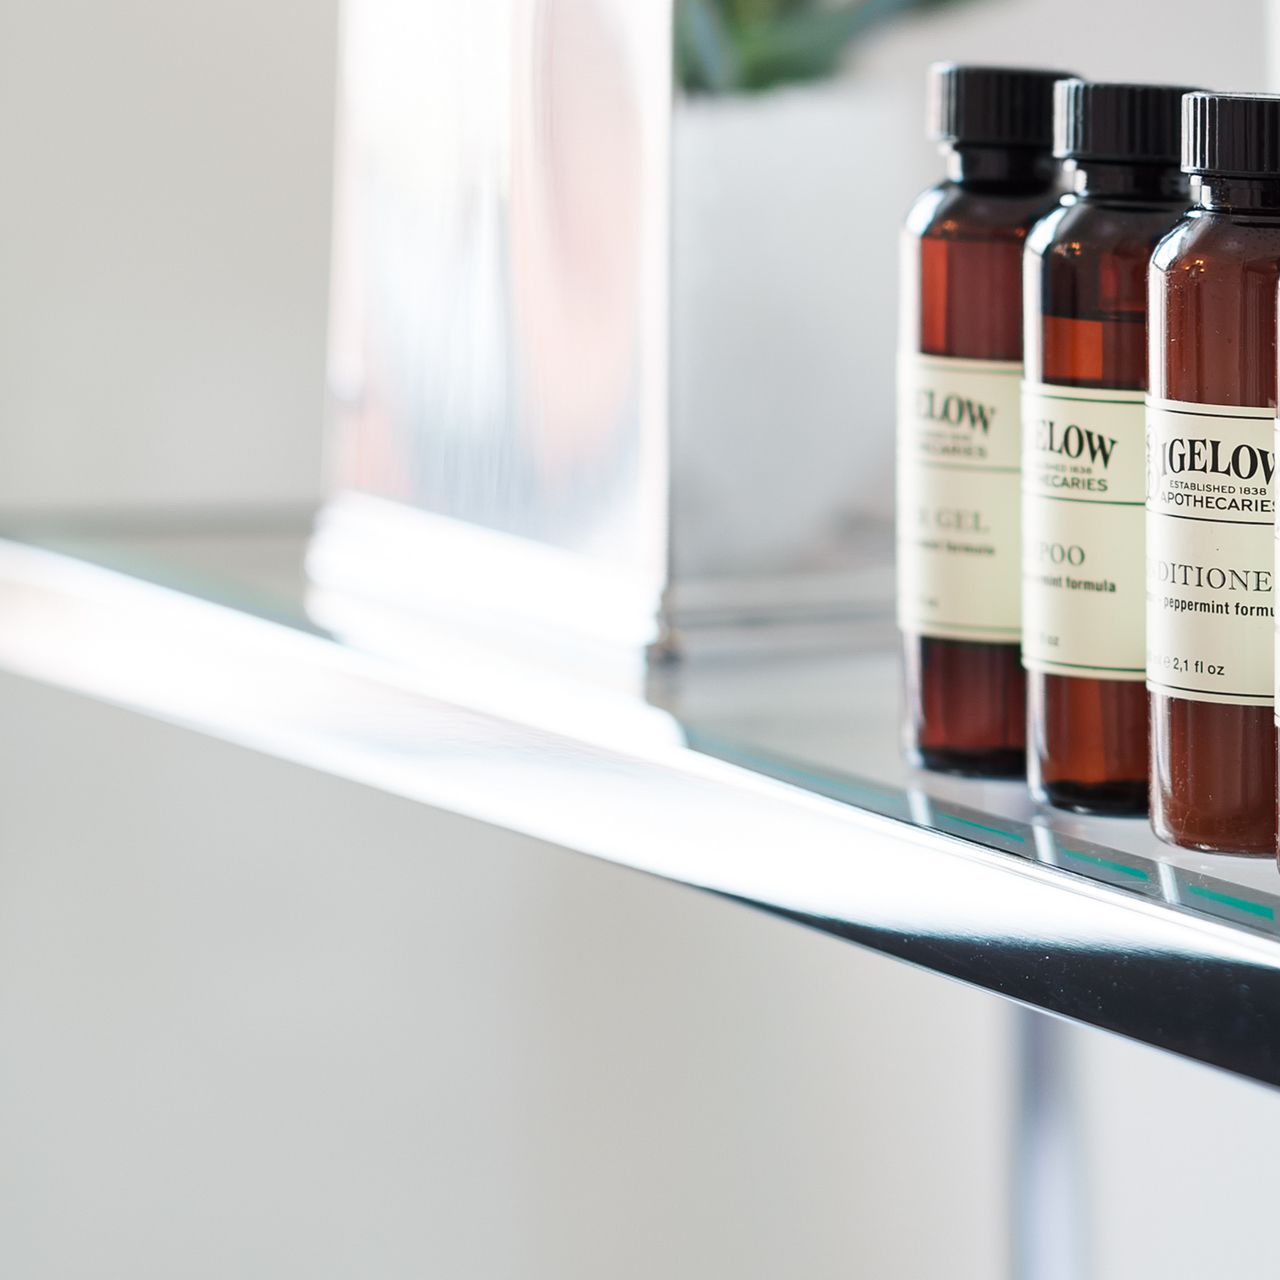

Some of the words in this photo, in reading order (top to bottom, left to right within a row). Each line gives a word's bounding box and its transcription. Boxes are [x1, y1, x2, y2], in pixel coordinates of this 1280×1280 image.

[1169, 479, 1236, 494] ESTABLISHED
[1239, 486, 1267, 496] 1838
[1066, 575, 1117, 593] formula
[1164, 596, 1230, 616] peppermint
[1172, 656, 1190, 673] 2,1
[1194, 659, 1205, 673] fl
[1207, 663, 1225, 676] oz
